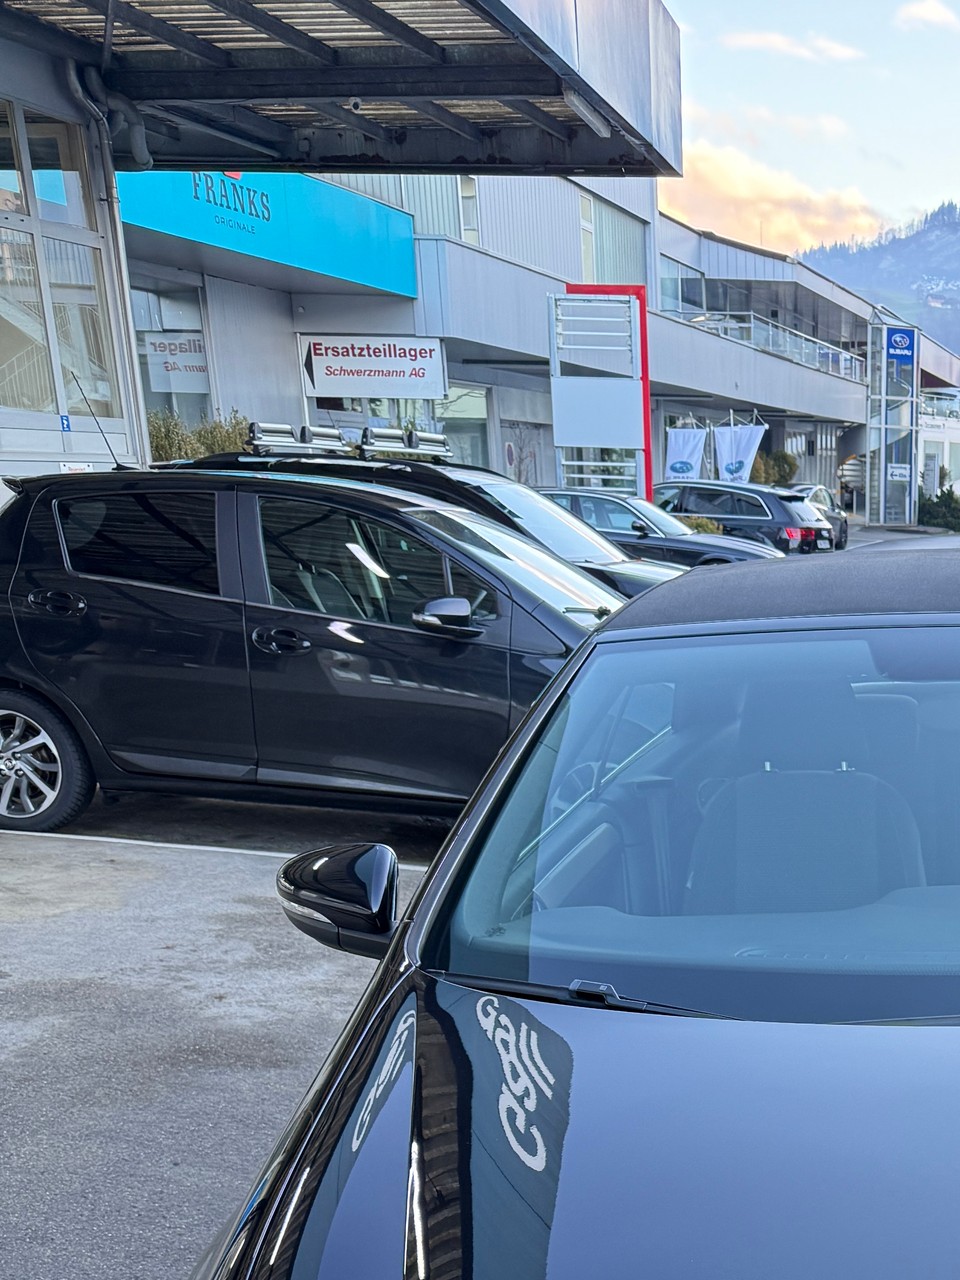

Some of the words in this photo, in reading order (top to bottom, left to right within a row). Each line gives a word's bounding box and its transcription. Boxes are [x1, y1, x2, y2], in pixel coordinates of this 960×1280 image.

[191, 171, 271, 222] FRANKS
[214, 215, 256, 235] ORIGINALE
[312, 342, 435, 361] Ersatzteillager
[325, 366, 405, 378] Schwerzmann
[409, 368, 426, 378] AG
